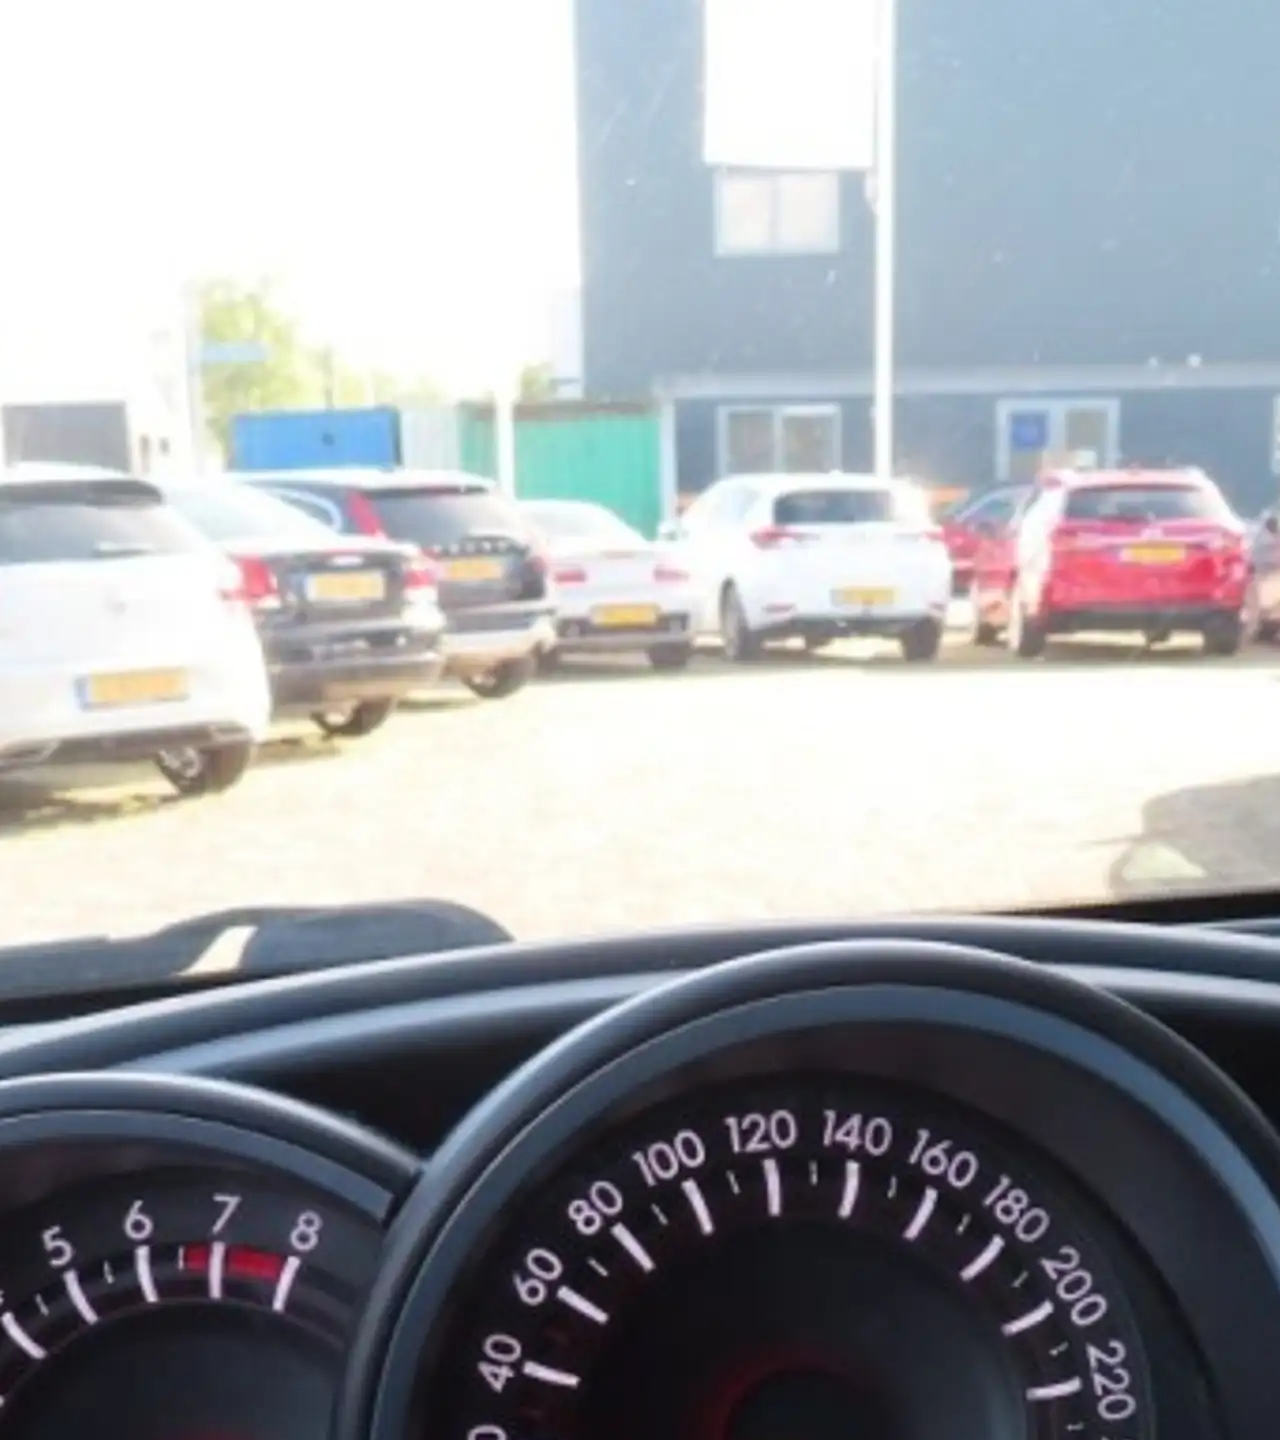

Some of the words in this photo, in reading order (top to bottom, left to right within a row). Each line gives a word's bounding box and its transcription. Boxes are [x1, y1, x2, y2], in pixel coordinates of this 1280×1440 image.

[631, 1129, 707, 1188] 100
[724, 1108, 798, 1154] 120
[822, 1110, 893, 1157] 140
[908, 1128, 979, 1190] 160
[123, 1198, 155, 1242] 6
[211, 1192, 243, 1236] 7
[288, 1209, 324, 1254] 8
[566, 1179, 624, 1237] 80
[982, 1175, 1051, 1243] 180
[41, 1224, 74, 1268] 5
[512, 1247, 564, 1307] 60
[1039, 1245, 1109, 1328] 200
[476, 1333, 523, 1393] 40
[1085, 1339, 1137, 1421] 220
